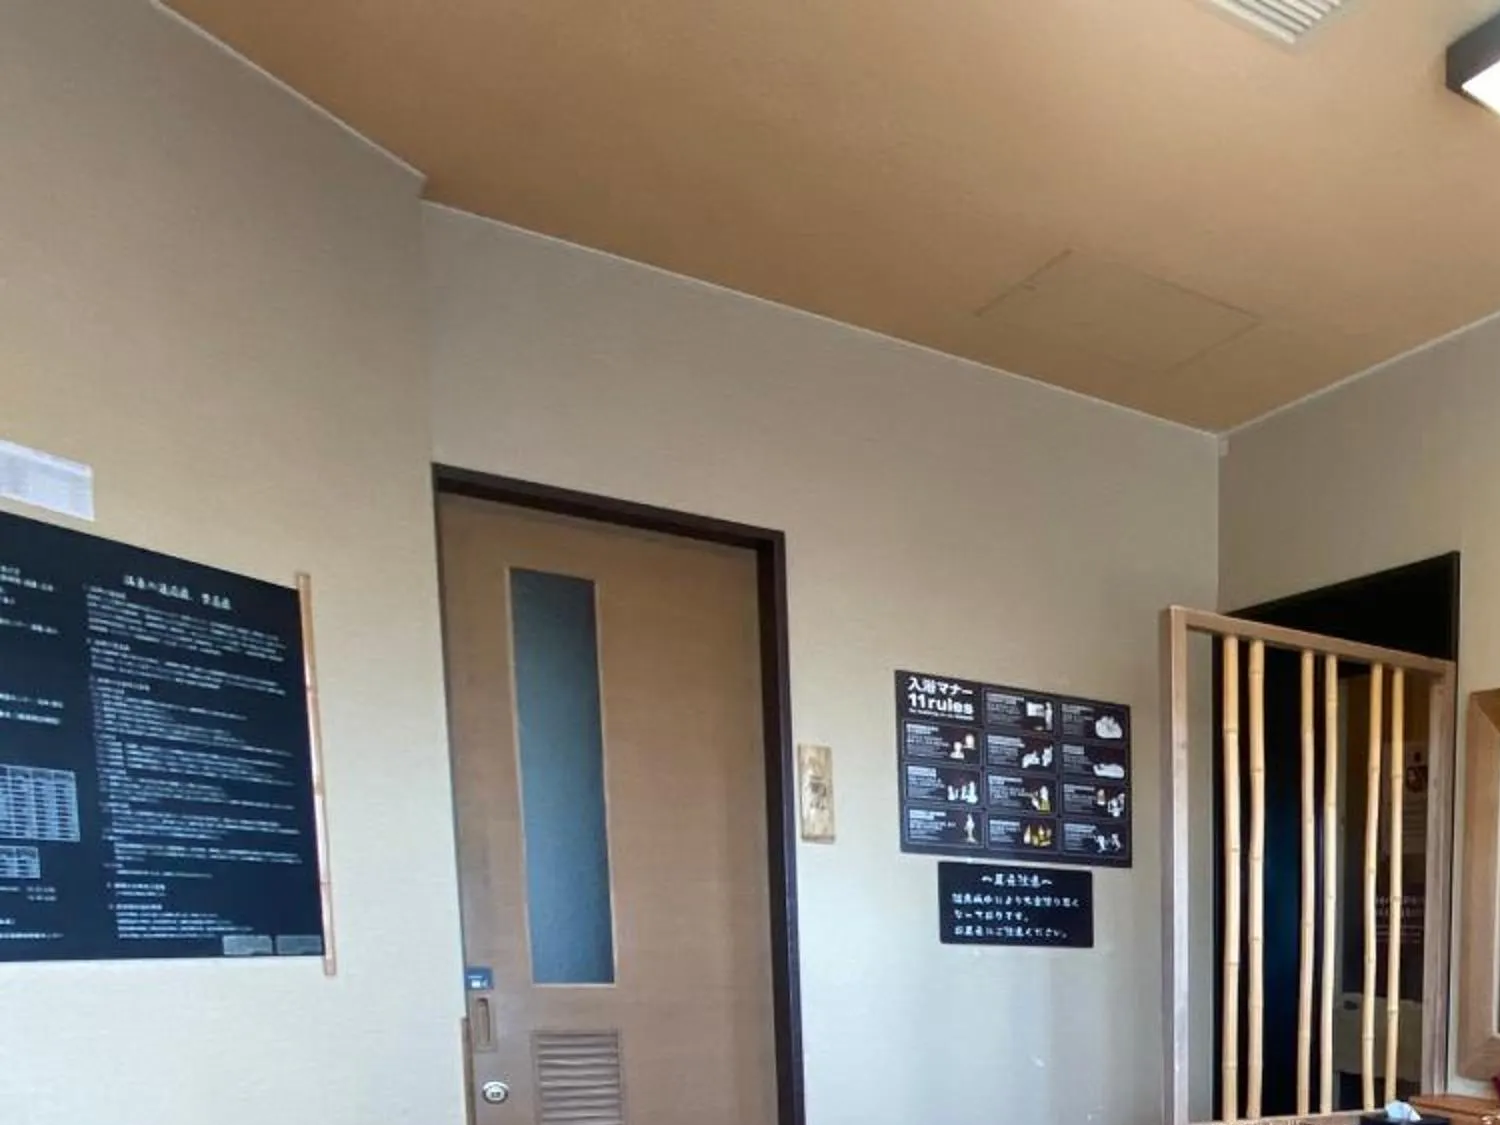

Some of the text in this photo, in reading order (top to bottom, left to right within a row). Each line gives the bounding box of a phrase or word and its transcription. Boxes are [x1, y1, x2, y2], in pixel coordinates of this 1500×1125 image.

[908, 676, 974, 696] 入浴マナー
